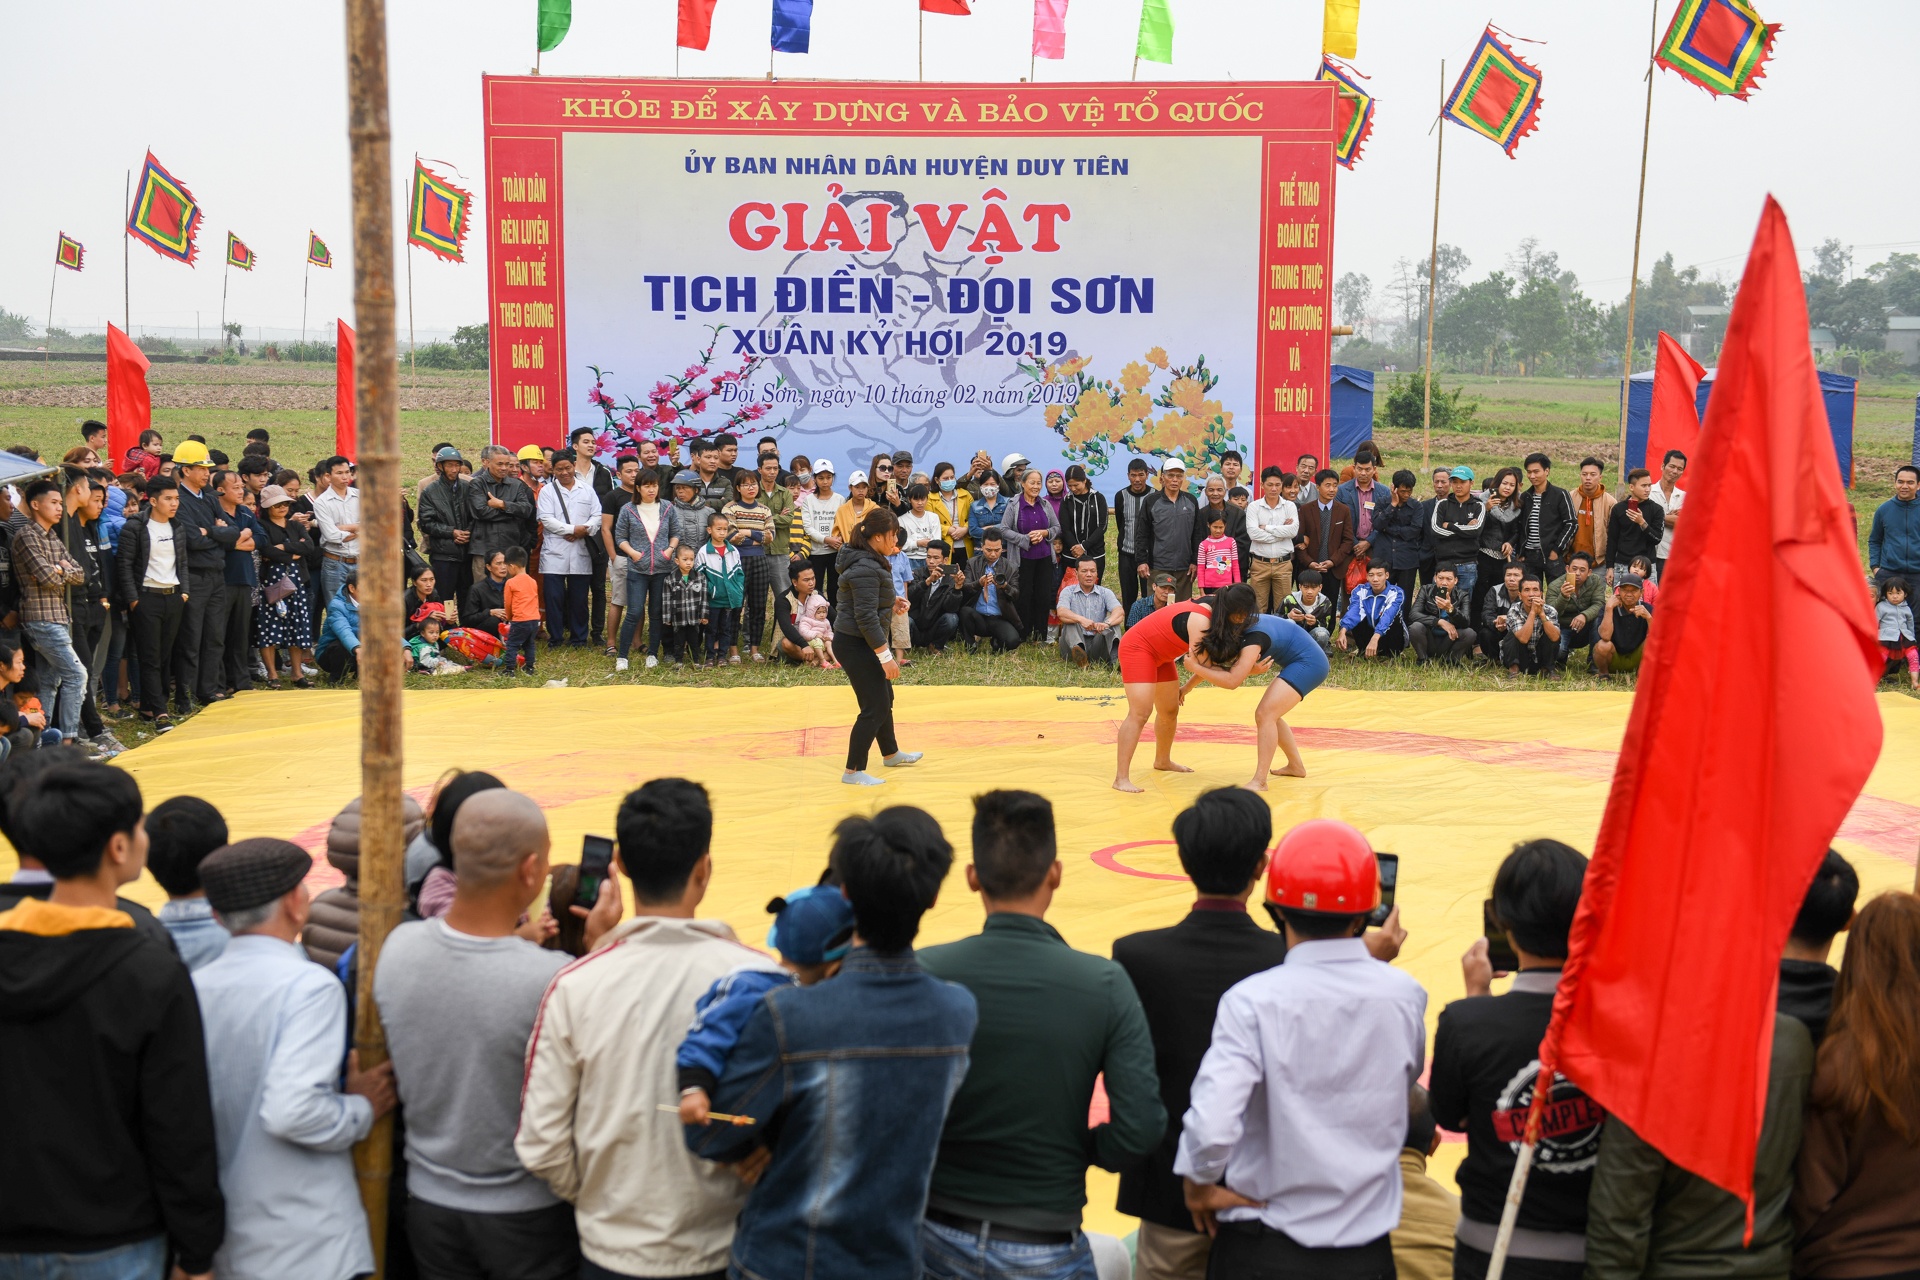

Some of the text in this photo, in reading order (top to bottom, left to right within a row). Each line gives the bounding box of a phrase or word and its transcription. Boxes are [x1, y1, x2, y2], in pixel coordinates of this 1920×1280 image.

[562, 88, 1264, 128] KHỎE ĐỂ XÂY DỰNG VÀ BẢO VỆ TỔ QUỐC
[684, 148, 1129, 180] ỦY BAN NHÂN DÂN HUYỆN DUY TIÊN
[502, 171, 546, 203] TOÀN DÂN
[1279, 171, 1320, 207] THỂ THAO
[501, 213, 549, 250] RÈN LUYỆN
[728, 183, 1071, 265] GIẢI VẬT
[1277, 213, 1319, 248] ĐOÀN KẾT
[505, 251, 547, 287] THÂN THỂ
[1271, 262, 1323, 295] TRUNG THỰC
[643, 275, 757, 321] TỊCH
[774, 263, 893, 314] ĐIỀN
[947, 276, 1031, 323] ĐỌI
[1050, 274, 1154, 314] SƠN
[499, 302, 554, 329] THEO GƯƠNG
[1269, 303, 1323, 336] CAO THƯỢNG
[512, 336, 544, 369] BÁC HỒ
[732, 319, 1067, 364] XUÂN KỶ HỢI 2019
[1289, 342, 1300, 372] VÀ
[513, 380, 522, 410] VĨ
[721, 382, 1078, 408] Đọi Sơn, ngày 10 tháng 02 năm 2019
[1274, 379, 1293, 413] TIẾN
[1510, 1098, 1607, 1137] CMPLE
